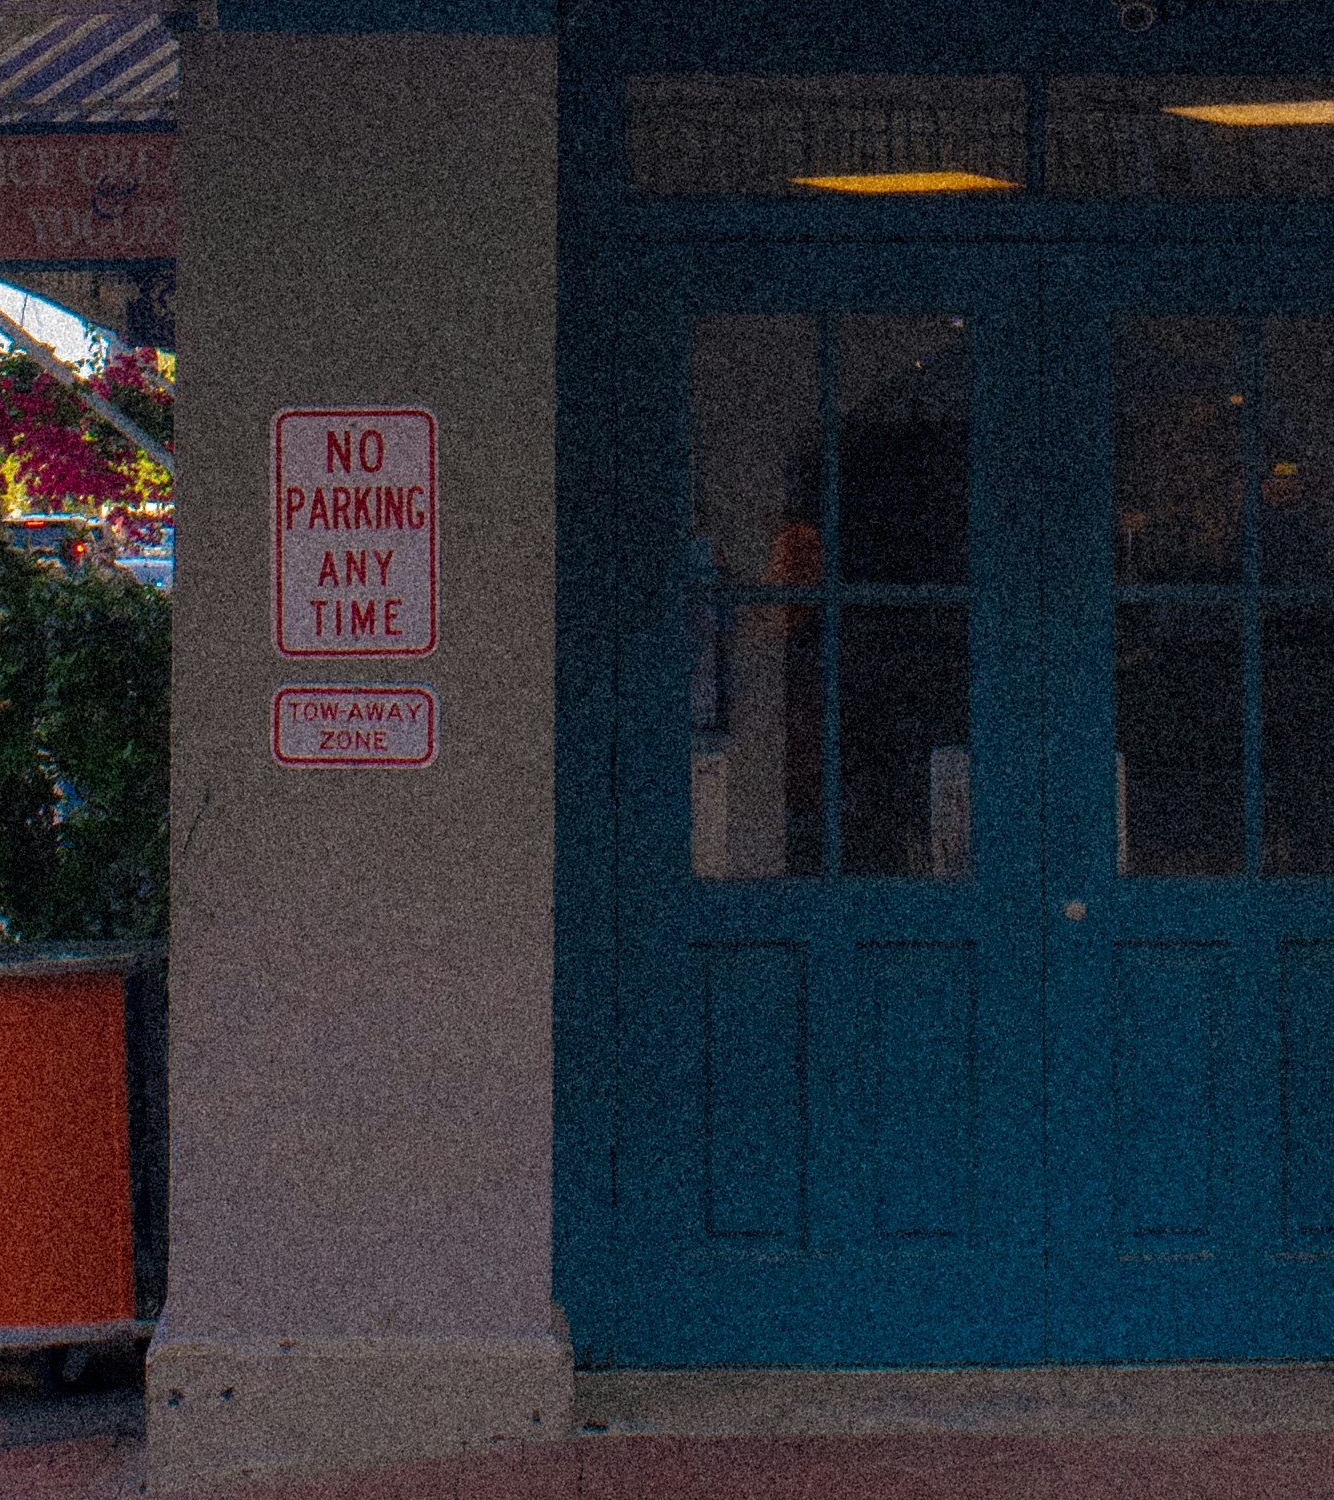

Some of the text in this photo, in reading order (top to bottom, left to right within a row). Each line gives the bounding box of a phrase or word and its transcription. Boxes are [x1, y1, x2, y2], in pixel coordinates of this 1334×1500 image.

[325, 429, 385, 474] NO
[285, 484, 426, 530] PARKING
[317, 549, 396, 587] ANY
[309, 599, 404, 636] TIME
[287, 700, 423, 722] TOW-AWAY
[318, 730, 389, 752] ZONE
